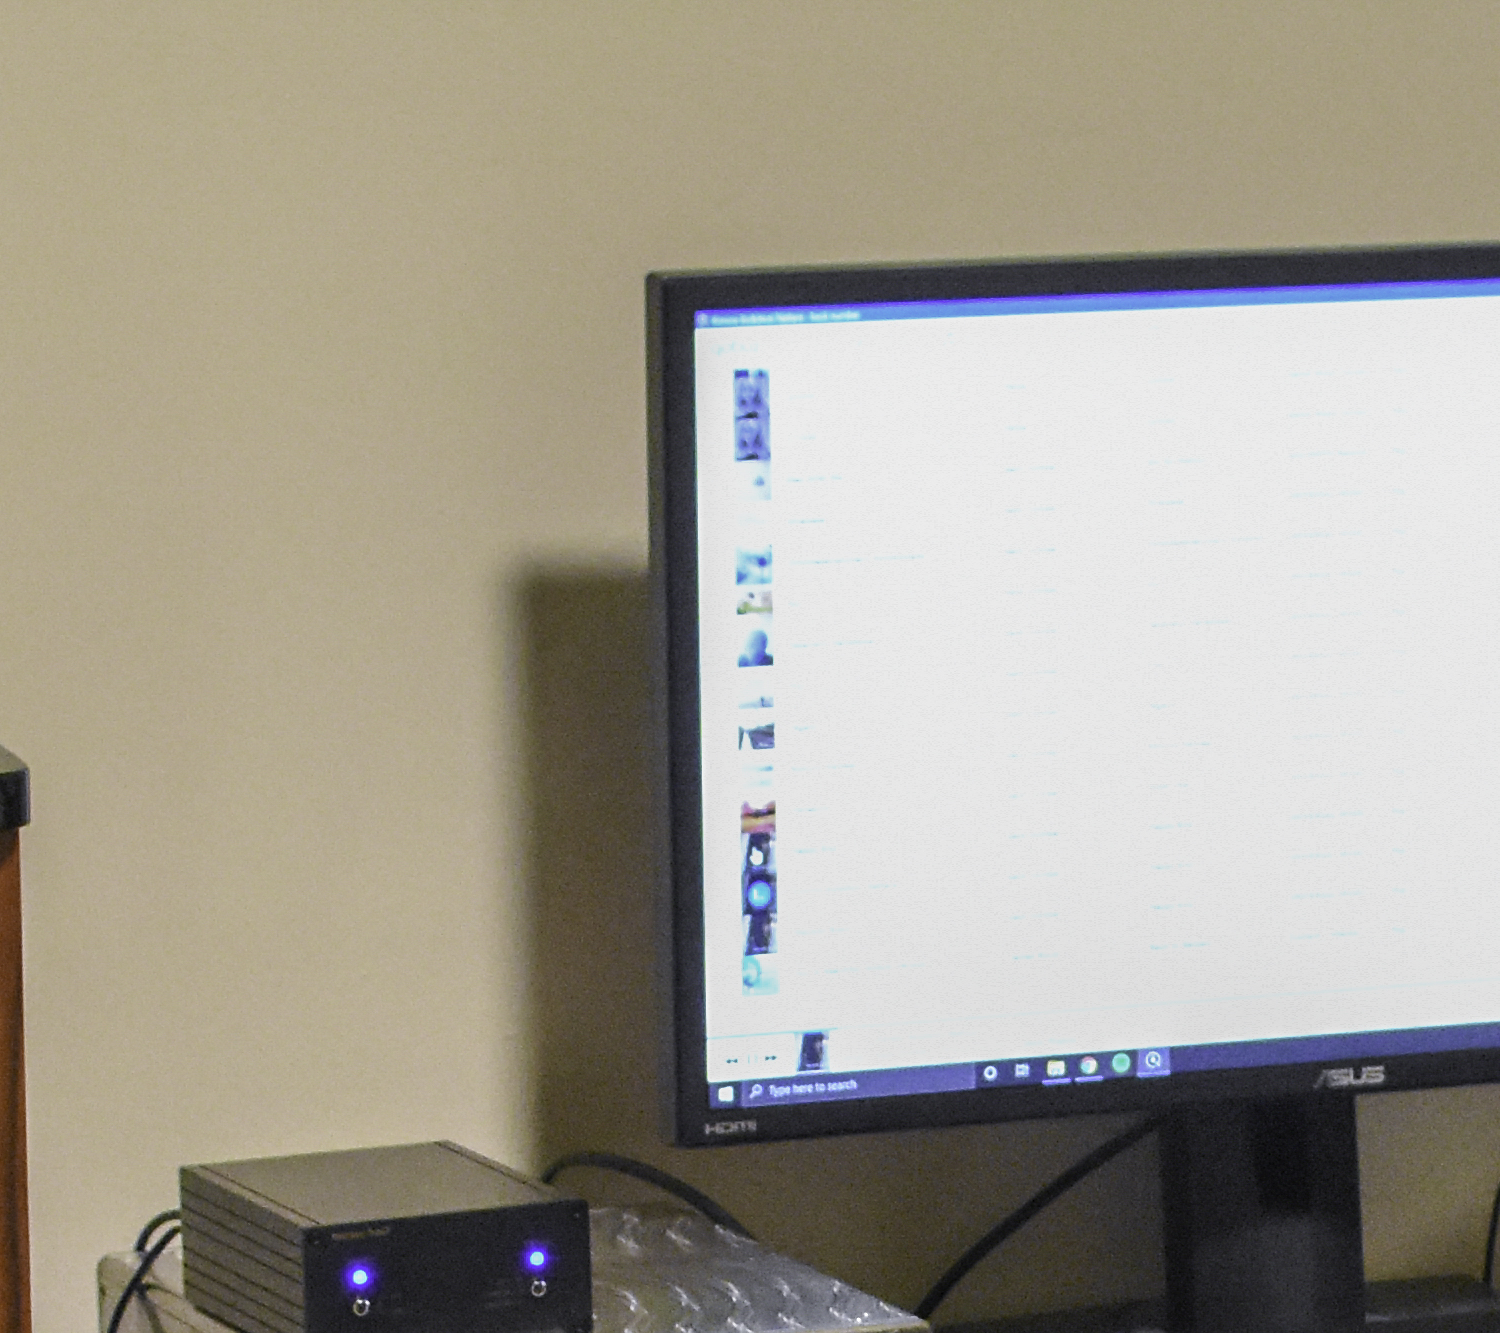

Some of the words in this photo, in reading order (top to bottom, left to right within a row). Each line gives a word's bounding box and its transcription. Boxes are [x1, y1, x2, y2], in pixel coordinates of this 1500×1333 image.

[1313, 1065, 1385, 1089] ASUS
[768, 1084, 791, 1098] Type
[792, 1083, 813, 1094] here
[815, 1082, 826, 1092] to
[827, 1079, 858, 1092] search
[705, 1119, 757, 1135] HDMI
